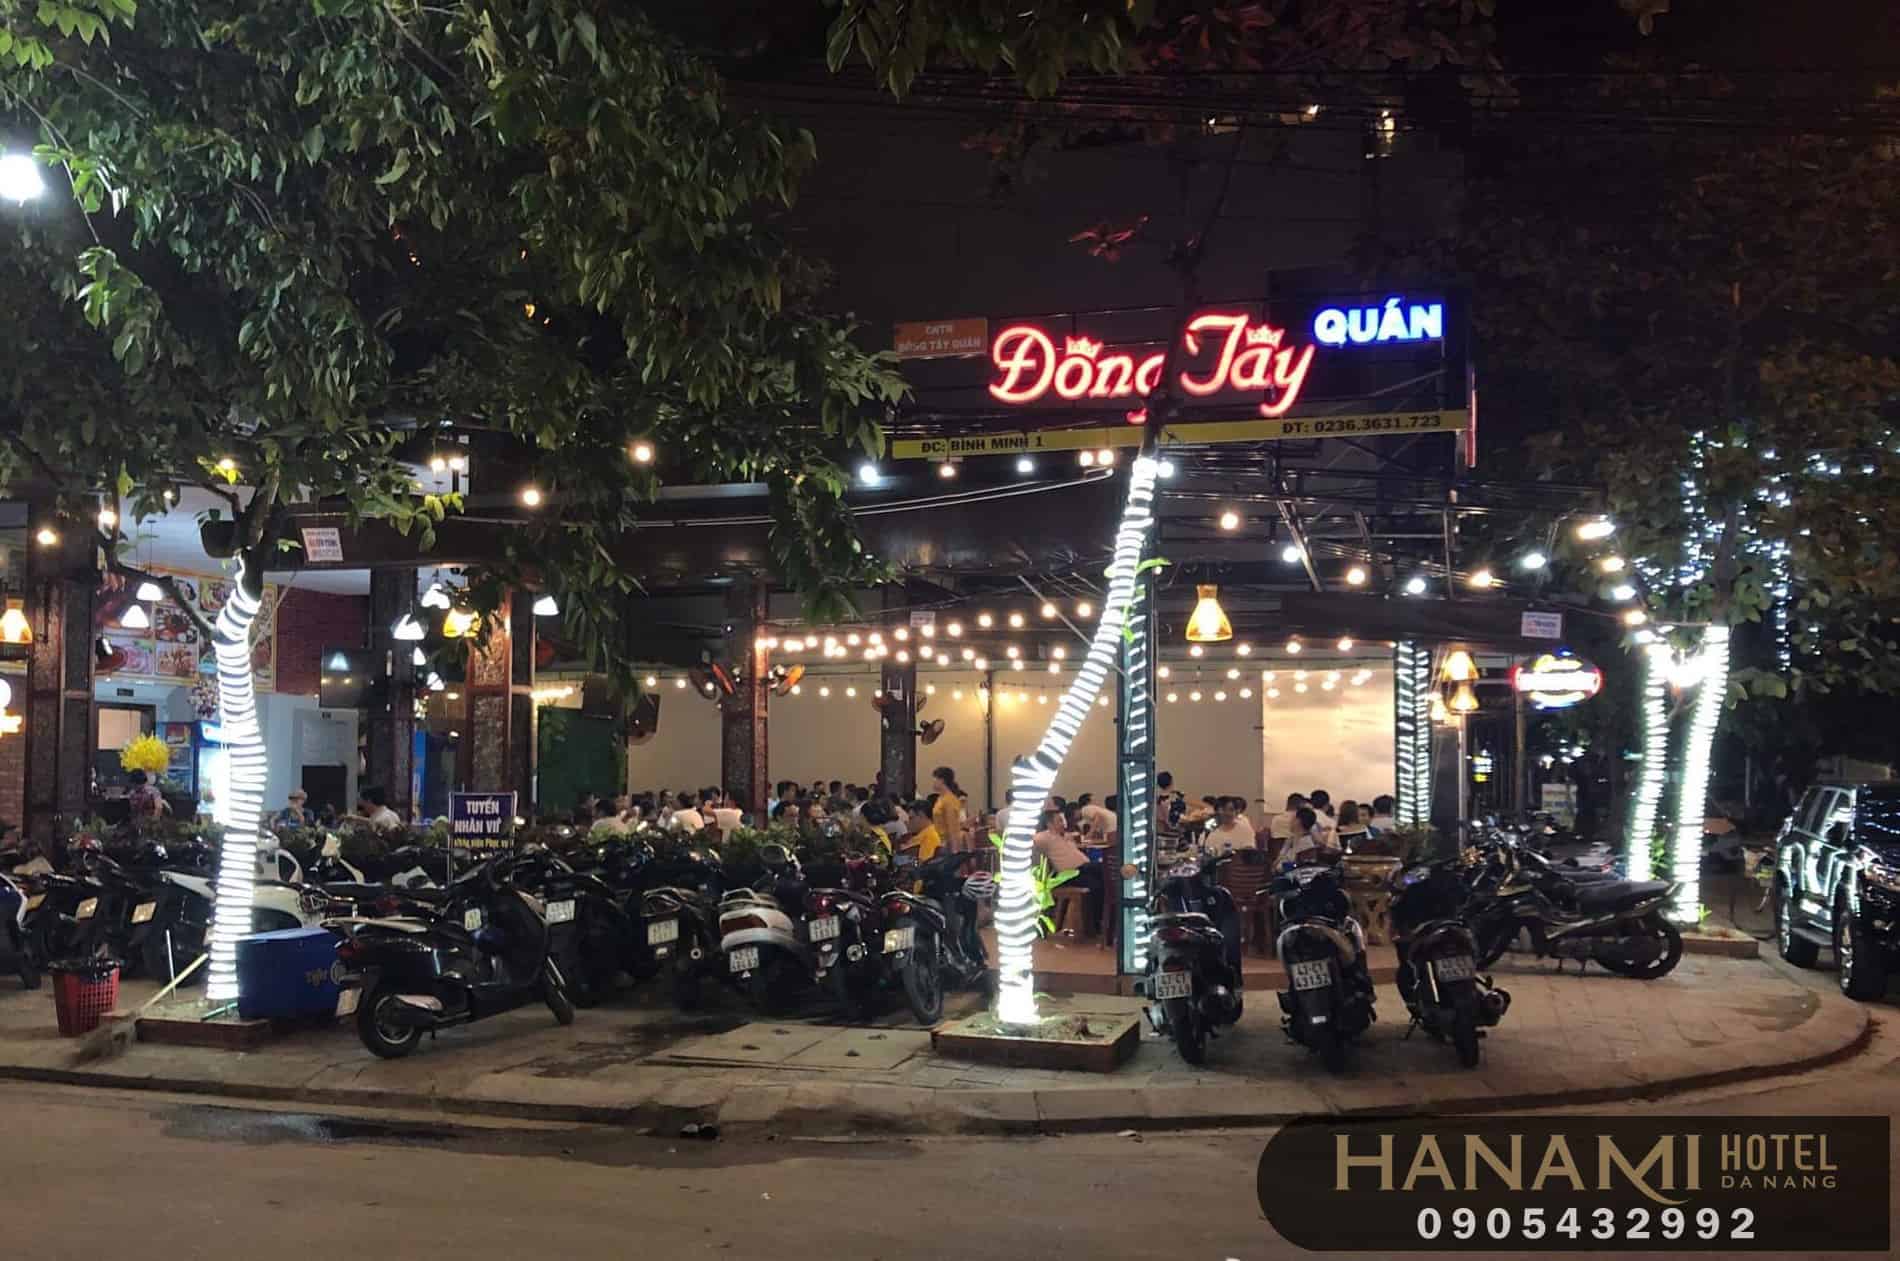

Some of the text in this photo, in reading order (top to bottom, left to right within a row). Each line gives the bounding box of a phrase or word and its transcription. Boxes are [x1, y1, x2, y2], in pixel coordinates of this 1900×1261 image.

[1314, 298, 1443, 345] QUÁN
[1181, 315, 1315, 417] Tây
[991, 436, 1029, 450] MINH
[1036, 436, 1043, 447] 1
